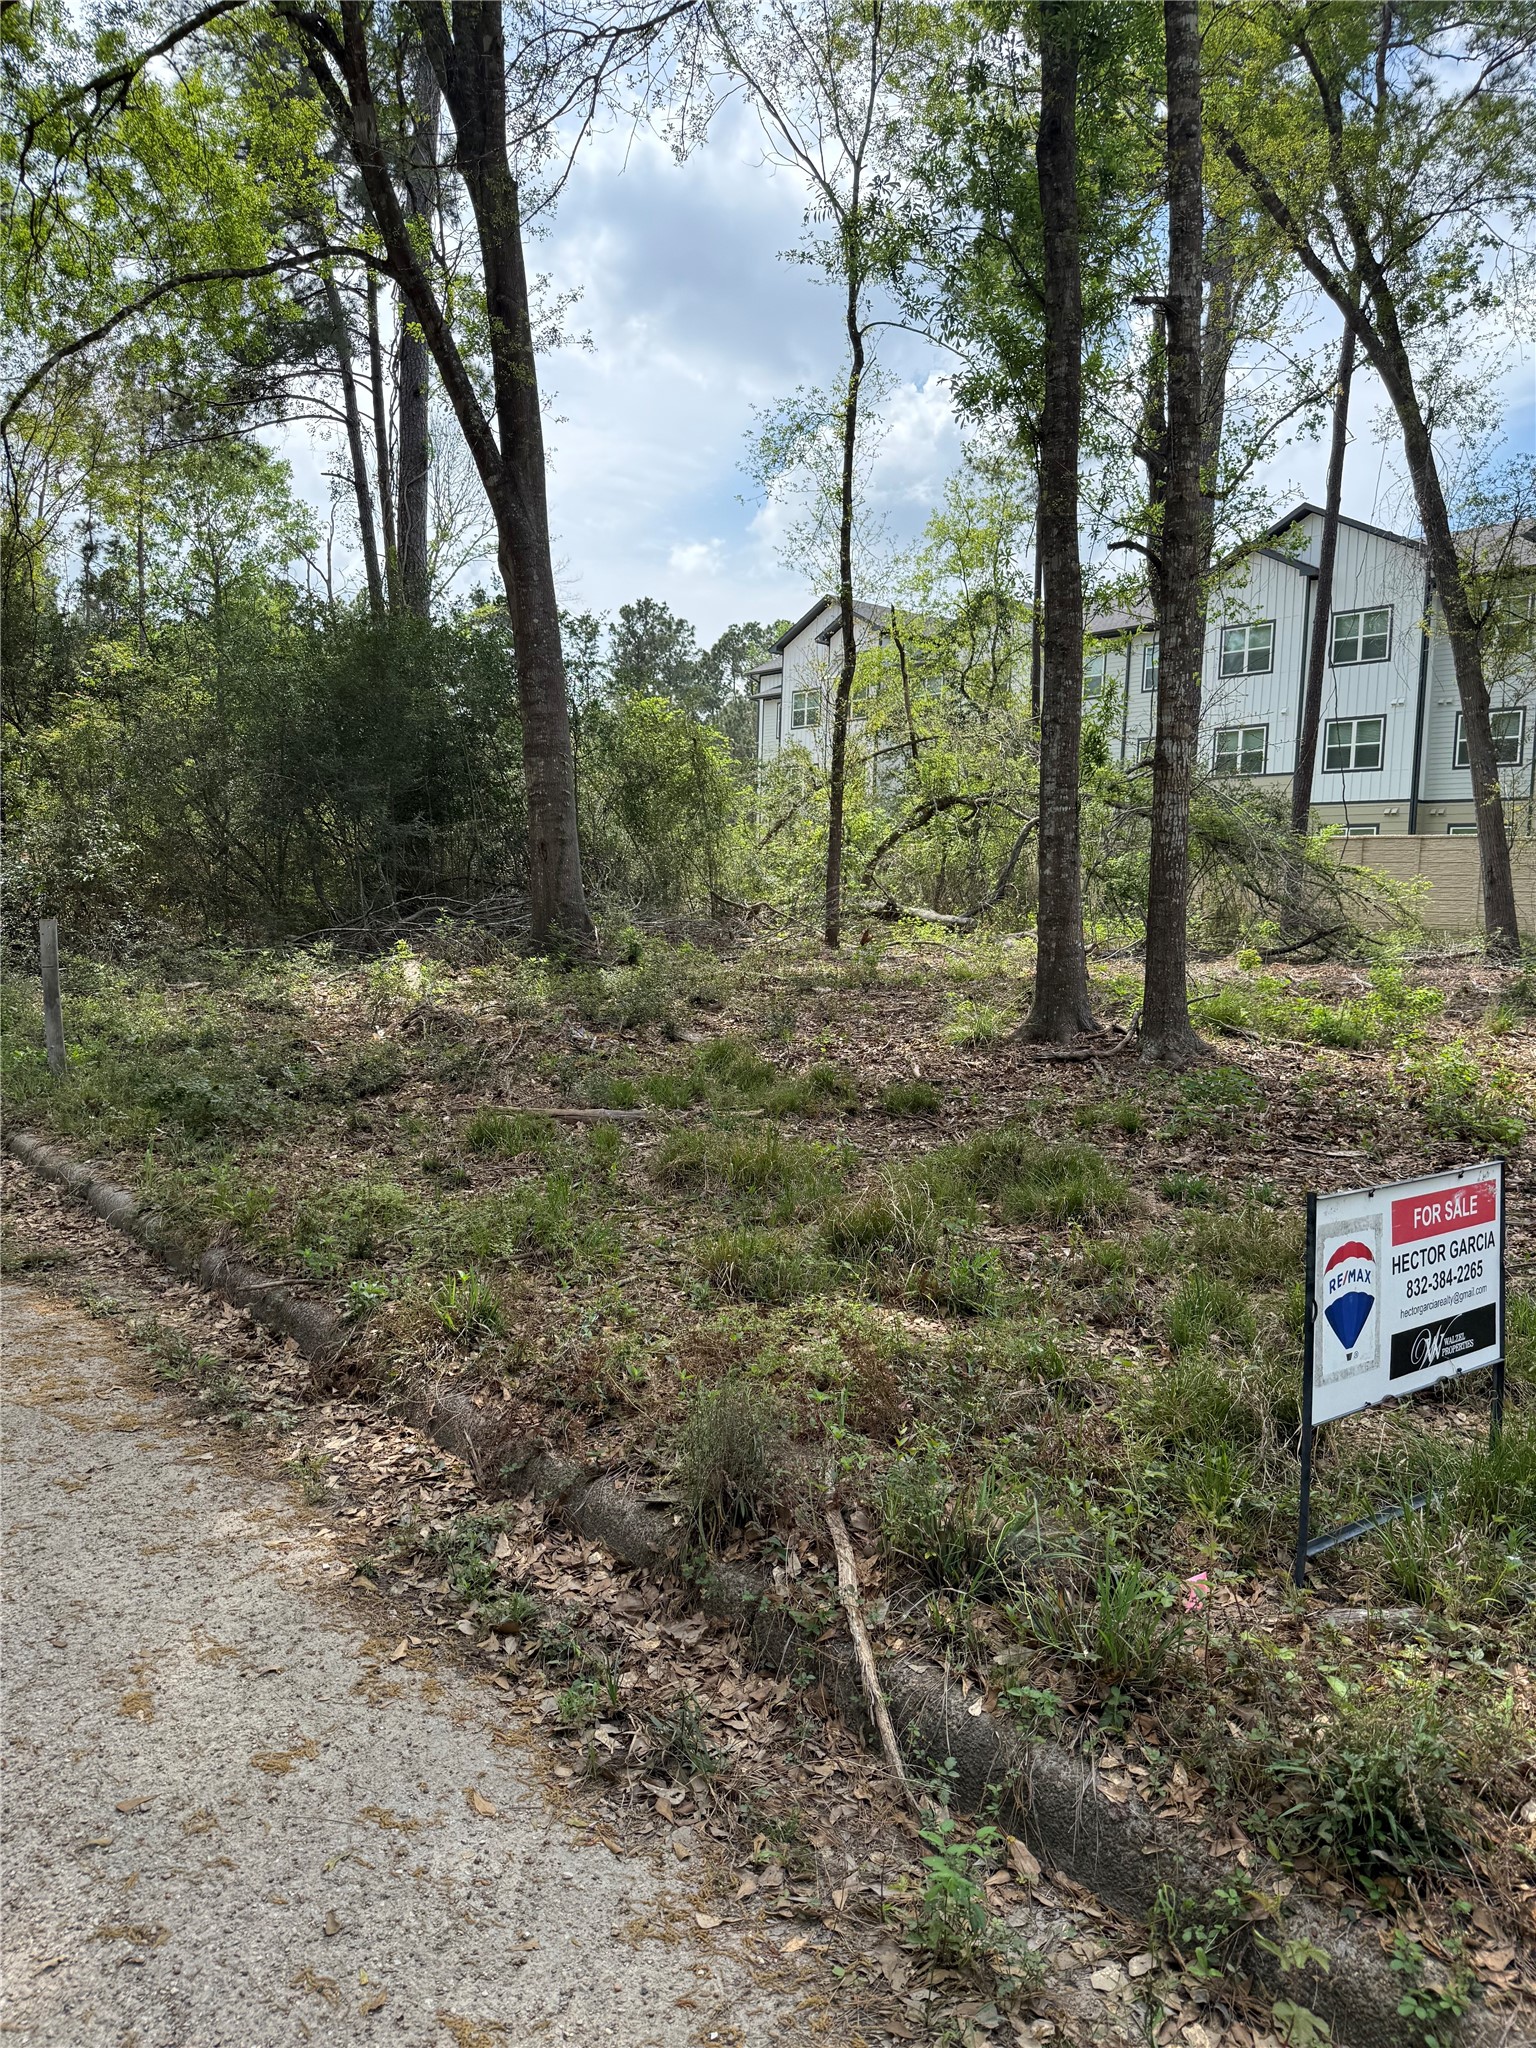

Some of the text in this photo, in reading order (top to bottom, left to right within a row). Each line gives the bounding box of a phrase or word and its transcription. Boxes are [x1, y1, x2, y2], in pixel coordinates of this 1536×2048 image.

[1414, 1195, 1478, 1229] FOR SALE
[1392, 1231, 1496, 1275] HECTOR GARCIA
[1329, 1268, 1371, 1294] RE/MAX
[1406, 1260, 1483, 1298] 832-384-2265
[1400, 1284, 1487, 1319] hectorgarciarealty@gmail.com
[1441, 1339, 1474, 1357] PROPERTIES
[1443, 1332, 1466, 1347] WALZEL
